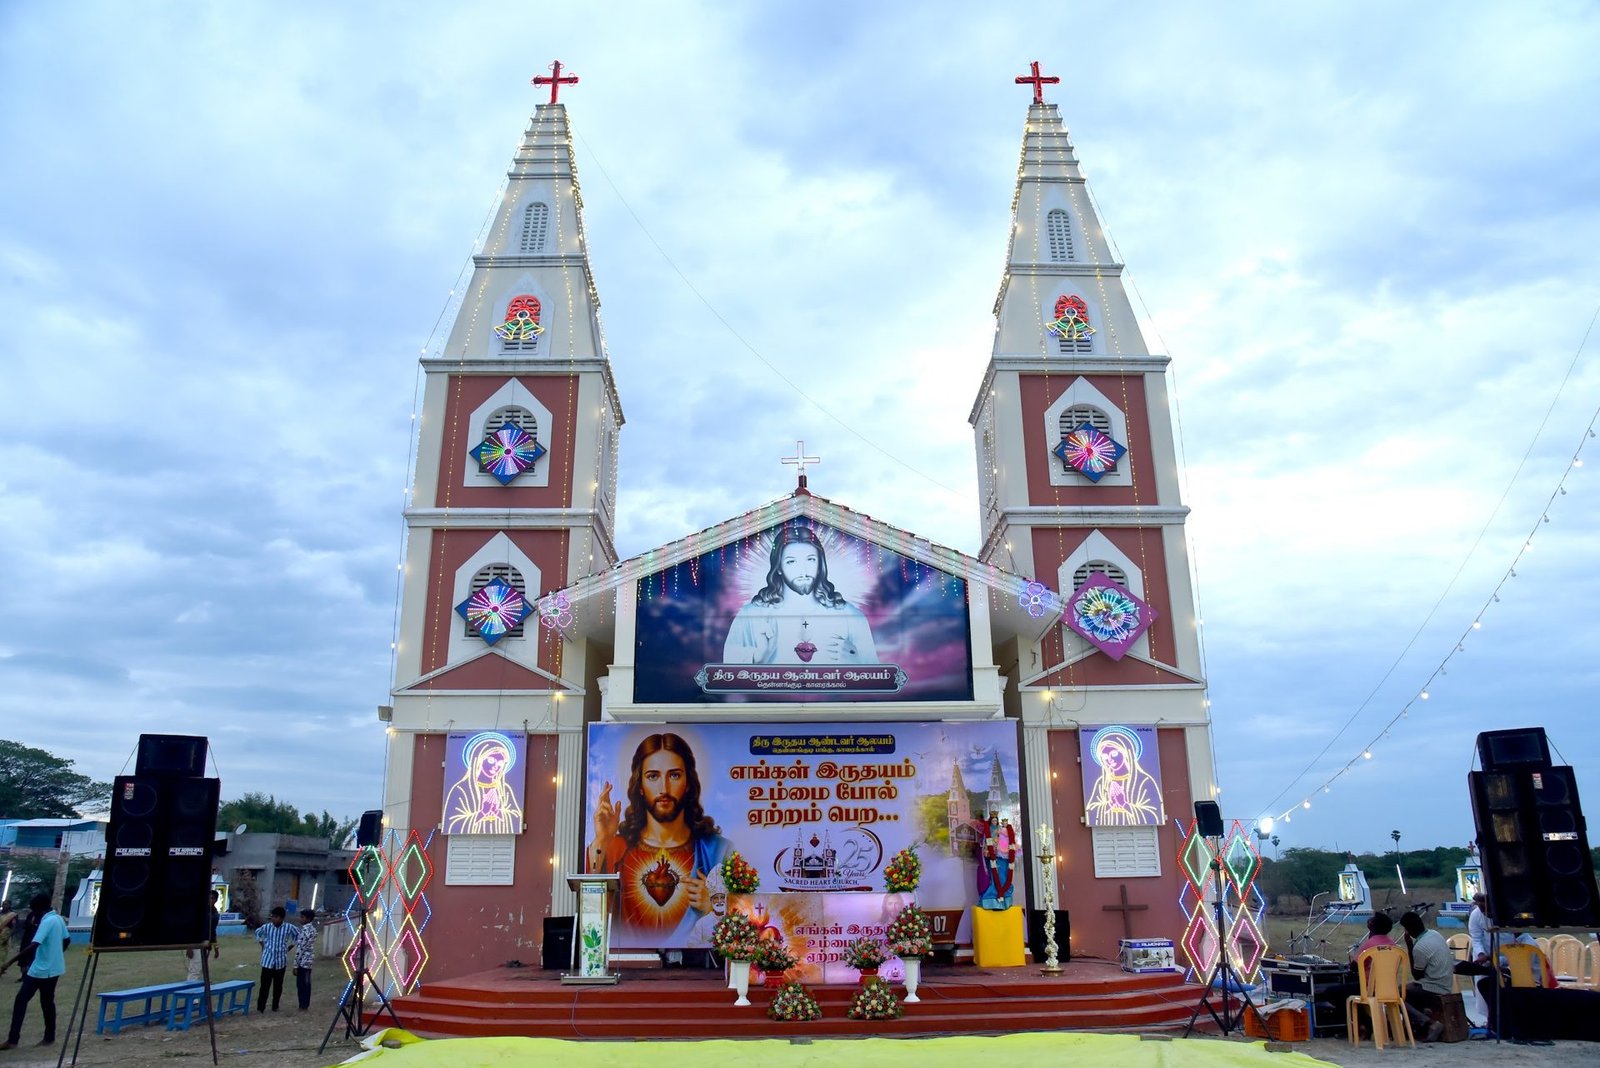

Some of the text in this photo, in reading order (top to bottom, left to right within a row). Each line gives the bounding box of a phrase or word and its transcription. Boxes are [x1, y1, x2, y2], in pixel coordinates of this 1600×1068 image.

[712, 669, 891, 681] திரு இருதய ஆண்டவர் ஆலயம்
[752, 735, 894, 748] திரு இருதய ஆண்டவர் ஆலயம்
[729, 758, 916, 783] எங்கள் இருதயம்
[749, 779, 898, 801] உம்மை போல்
[747, 801, 899, 828] ஏற்றம் பெற...
[840, 838, 874, 872] 25
[784, 878, 809, 886] SACRED
[810, 878, 831, 886] HEART
[842, 869, 868, 880] Years
[795, 922, 843, 935] எங்கள்
[934, 915, 947, 932] 07
